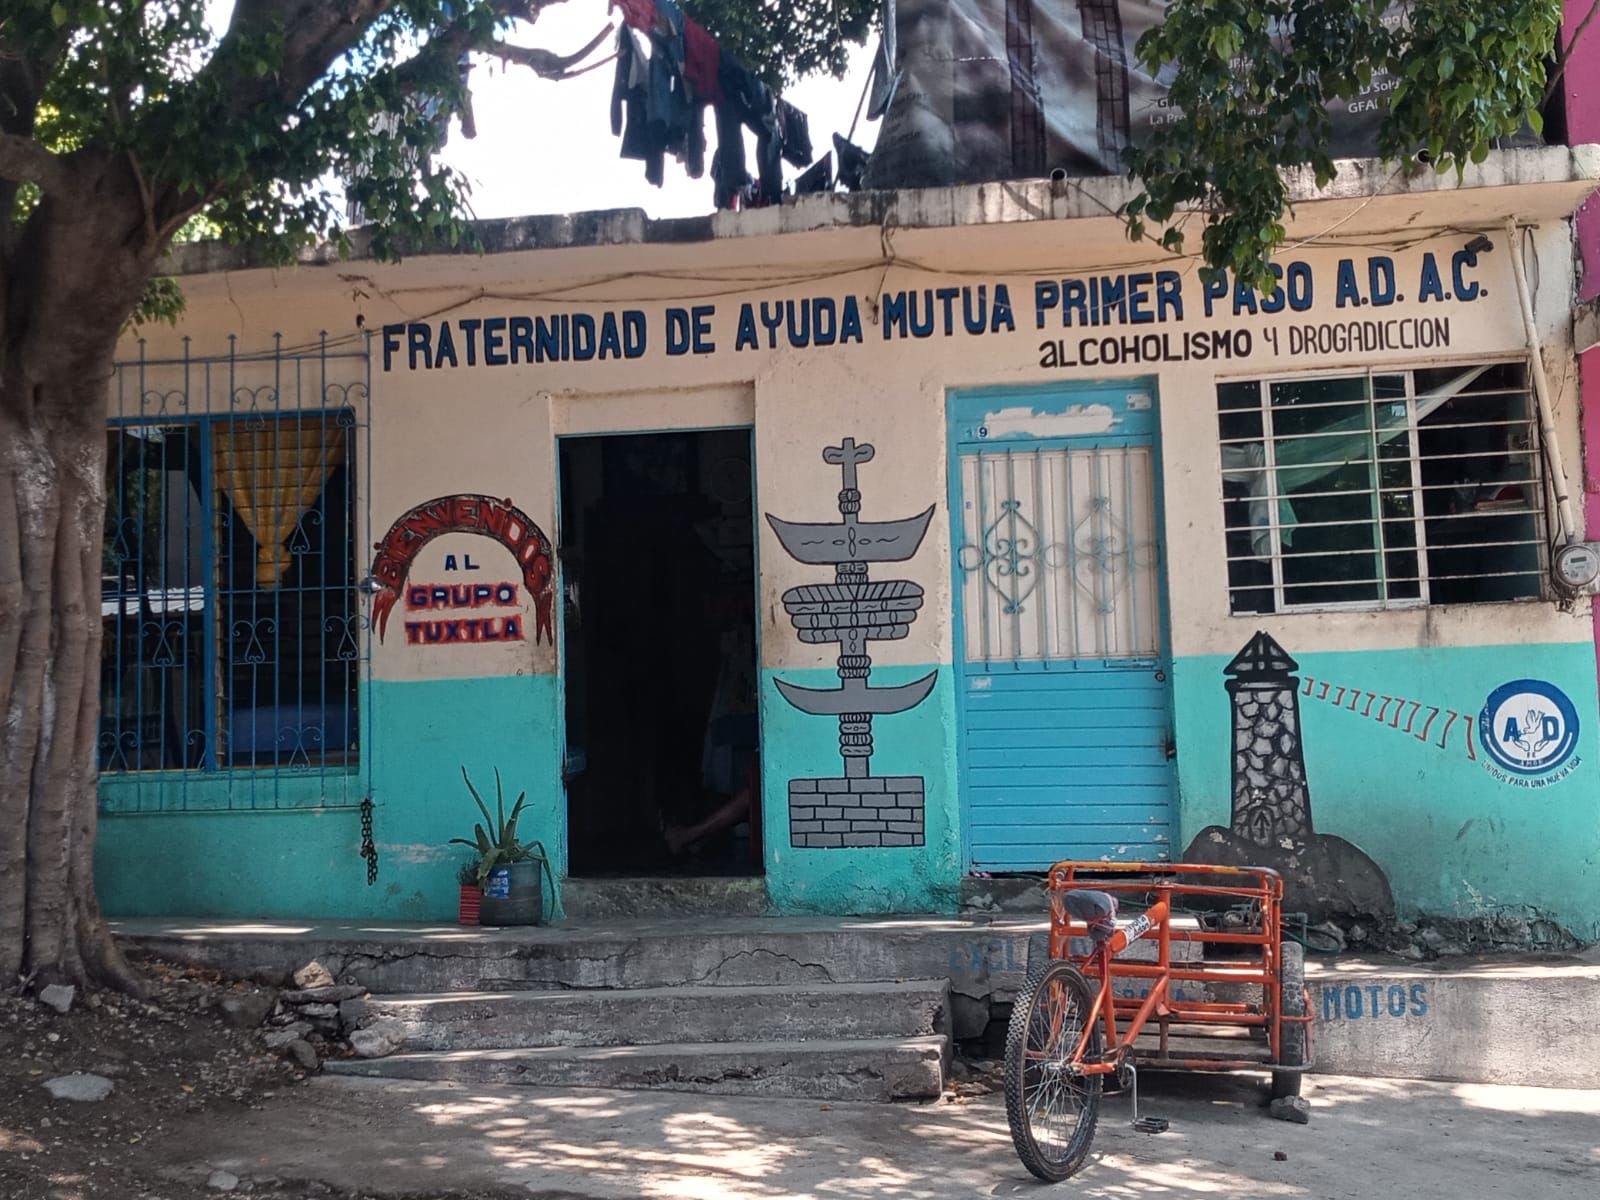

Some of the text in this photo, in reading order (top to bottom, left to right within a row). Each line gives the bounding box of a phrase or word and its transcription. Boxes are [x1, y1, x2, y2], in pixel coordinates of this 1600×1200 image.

[382, 250, 1488, 371] FRATERNIDAD DE AYUDA MUTUA PRIMER PASO A.D. A.C.
[1289, 317, 1450, 355] DROGADICCION
[407, 583, 518, 611] GRUPO
[405, 615, 524, 645] TUXTLA
[1508, 777, 1529, 788] PARA
[1530, 778, 1546, 788] UNA
[1546, 768, 1569, 785] NUEVA
[1322, 983, 1429, 1021] MOTOS
